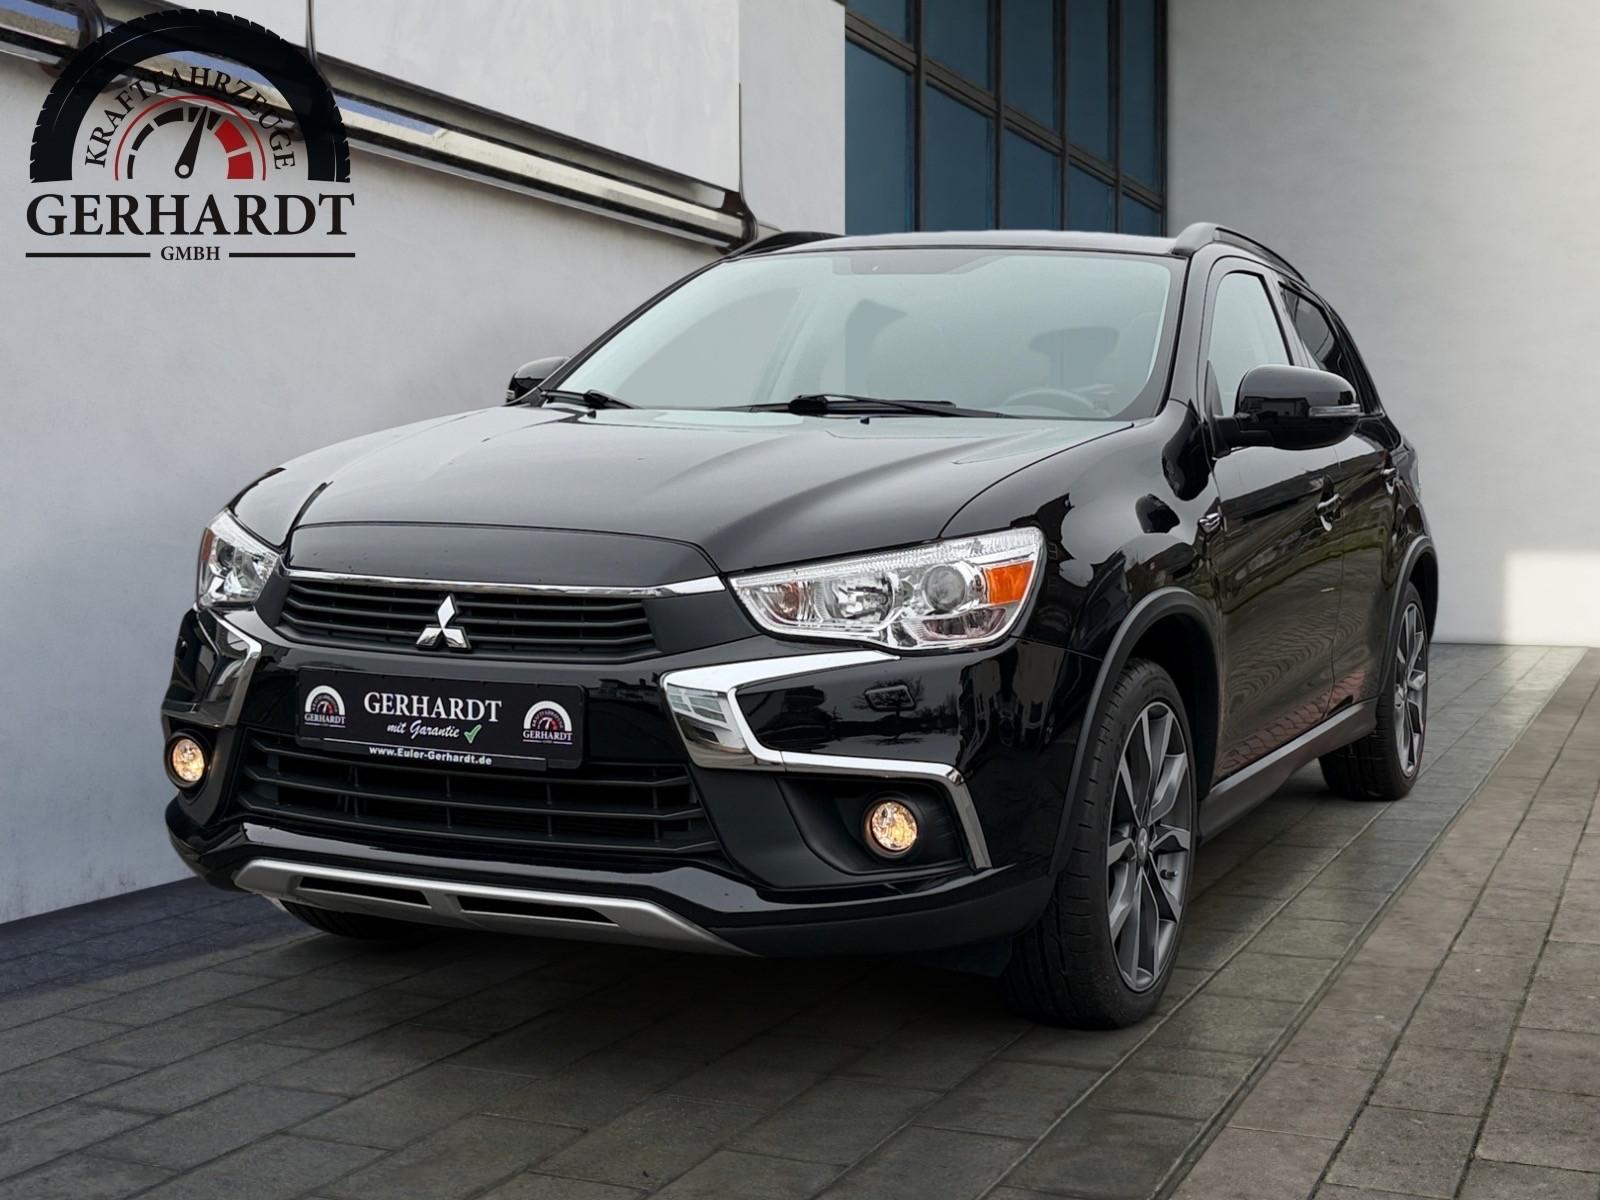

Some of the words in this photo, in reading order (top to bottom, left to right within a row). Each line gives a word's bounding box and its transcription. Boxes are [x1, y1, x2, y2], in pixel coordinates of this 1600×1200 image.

[364, 692, 502, 722] GERHARDT
[304, 713, 346, 725] GERHARDT
[387, 720, 407, 734] mit
[410, 720, 460, 739] Garantie
[523, 730, 573, 741] GERHARDT
[369, 745, 492, 766] www.Euler-Gerhardt.de
